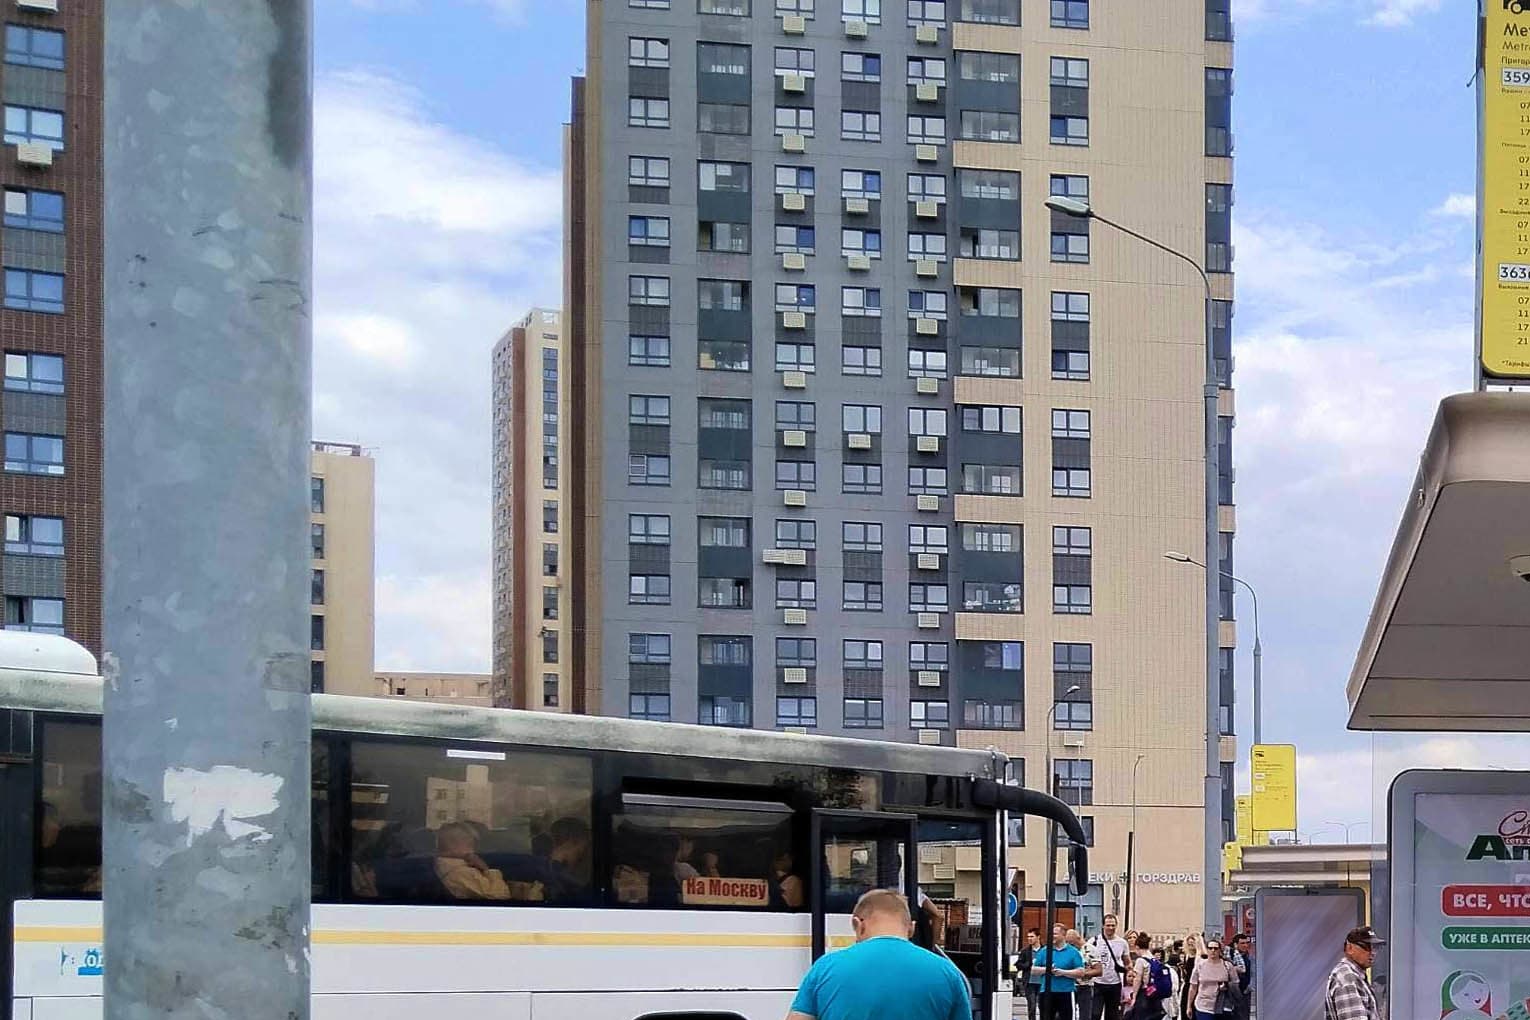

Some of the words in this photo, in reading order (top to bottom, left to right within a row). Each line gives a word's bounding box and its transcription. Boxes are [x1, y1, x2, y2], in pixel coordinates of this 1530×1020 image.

[1520, 115, 1530, 123] 11
[1518, 234, 1528, 242] 11
[1518, 323, 1529, 331] 17
[1137, 873, 1201, 885] ГОРЗДРАВ
[687, 878, 704, 895] На
[710, 879, 765, 900] Москву
[1453, 894, 1493, 910] ВСЕ,
[1450, 934, 1477, 943] УЖЕ
[1481, 934, 1489, 943] В
